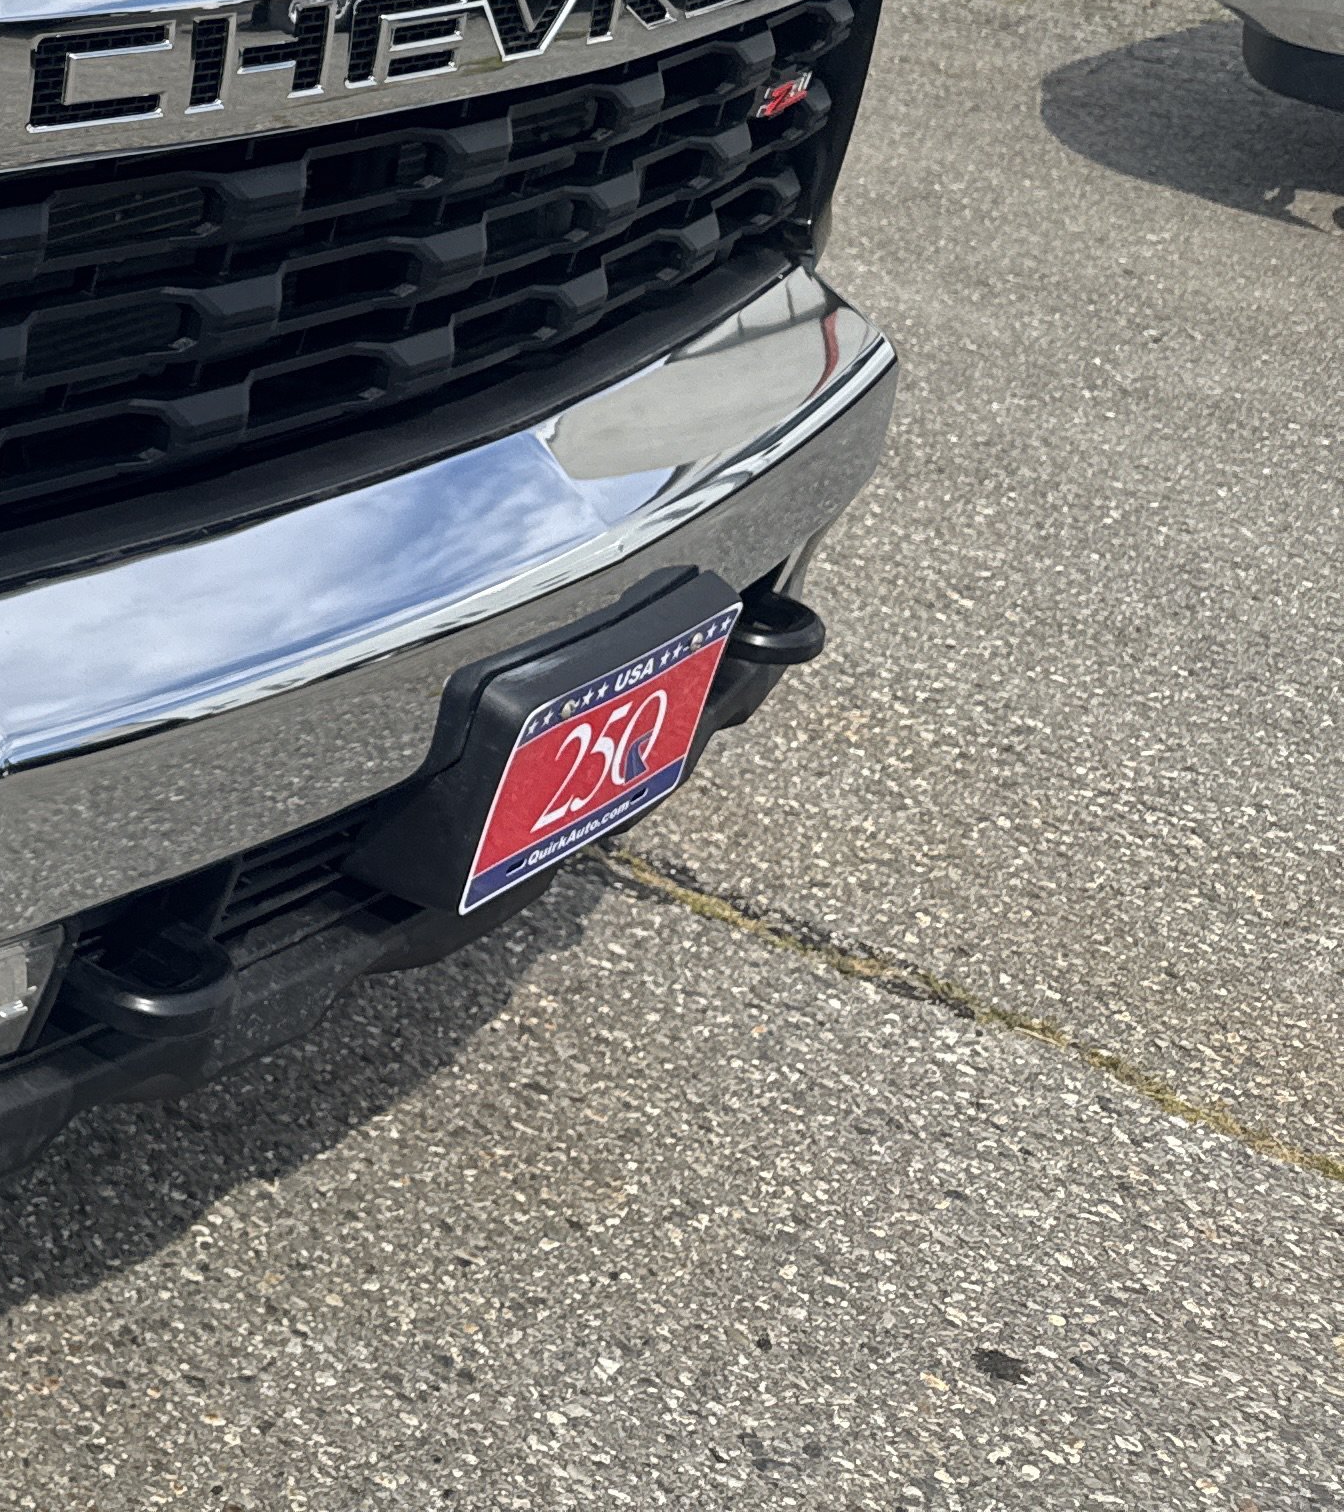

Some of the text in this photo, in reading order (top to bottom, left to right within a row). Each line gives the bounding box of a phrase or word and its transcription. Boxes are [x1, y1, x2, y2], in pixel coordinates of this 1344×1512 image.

[613, 655, 656, 692] USA
[530, 689, 668, 834] 250
[527, 799, 631, 866] QuirkAuto.com
